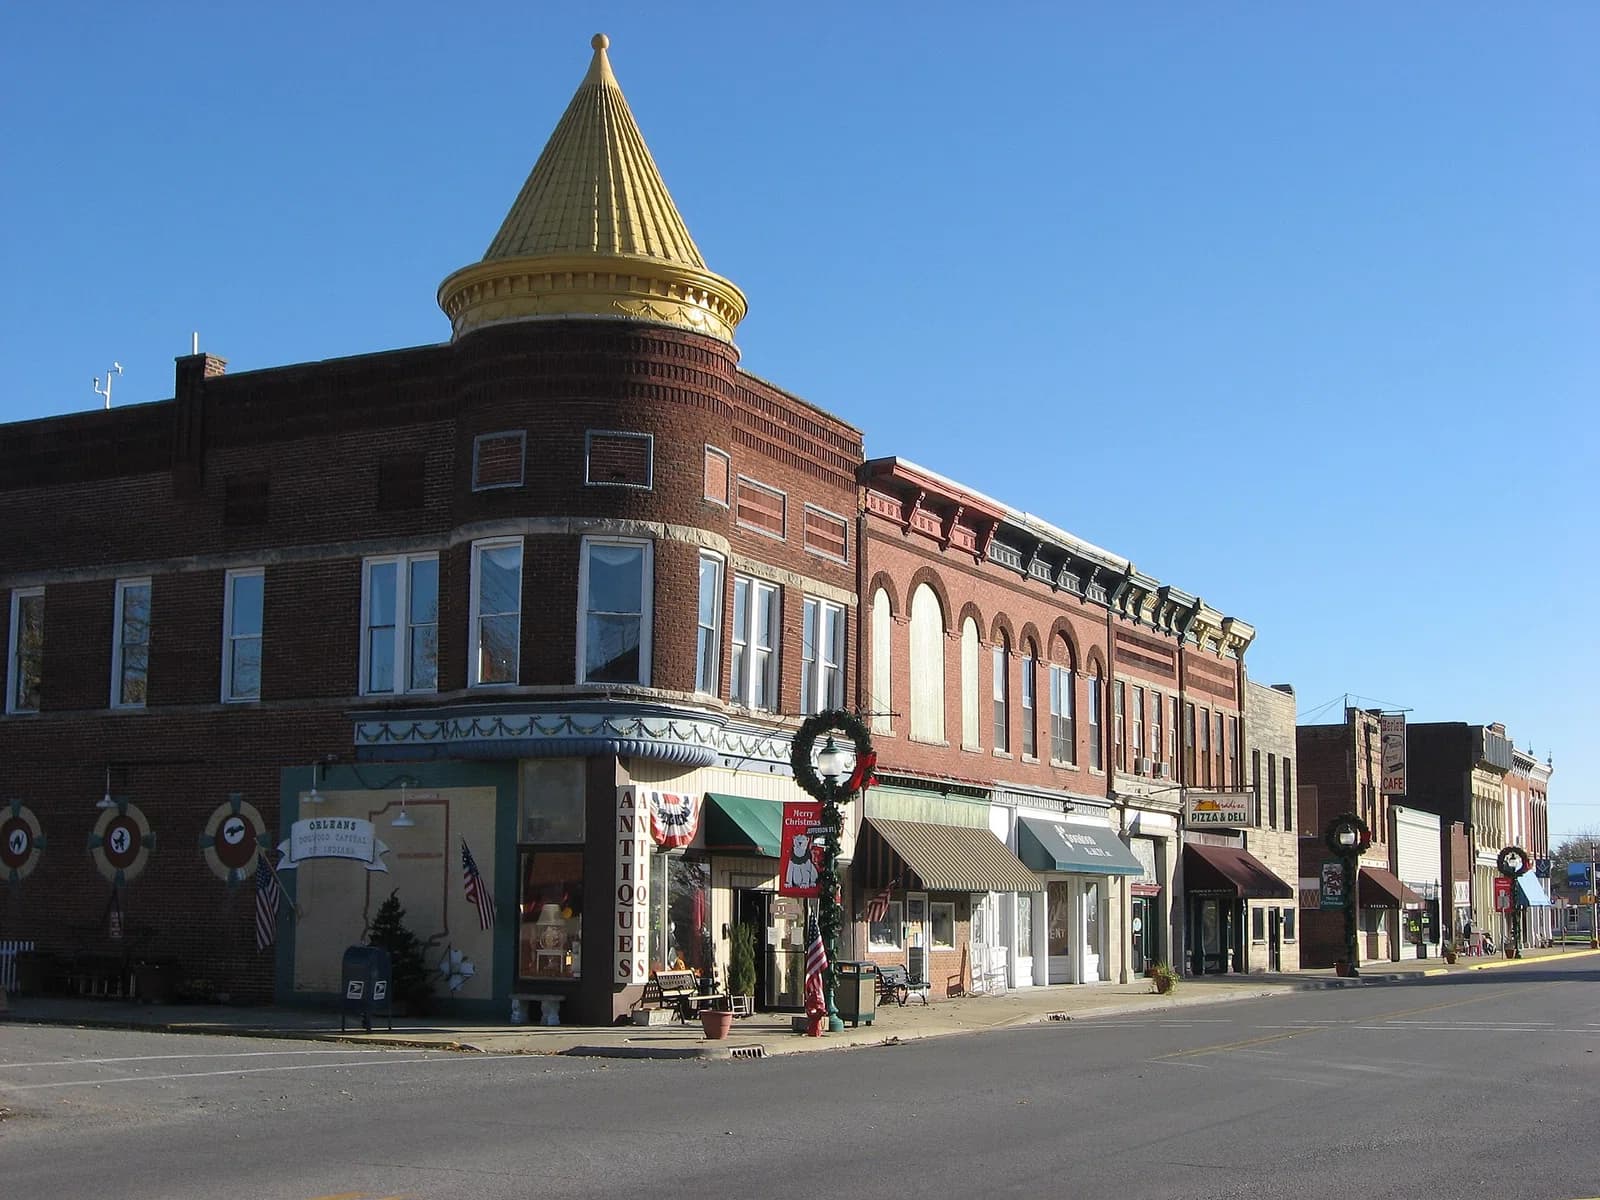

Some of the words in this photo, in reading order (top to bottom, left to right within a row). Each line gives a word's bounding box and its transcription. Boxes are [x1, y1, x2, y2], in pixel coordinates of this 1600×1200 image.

[1383, 777, 1403, 790] CAFE
[793, 810, 814, 820] Merry
[1191, 812, 1218, 822] PIZZA
[1220, 812, 1226, 822] &
[1227, 812, 1246, 822] DELI
[309, 820, 357, 831] ORLEANS
[785, 818, 821, 826] Christmas
[298, 832, 330, 844] DOGWOOD
[335, 832, 368, 845] CAPITAL
[323, 845, 355, 855] INDIANA
[617, 791, 635, 978] ANTIQUES
[636, 791, 648, 977] ANTIQUES
